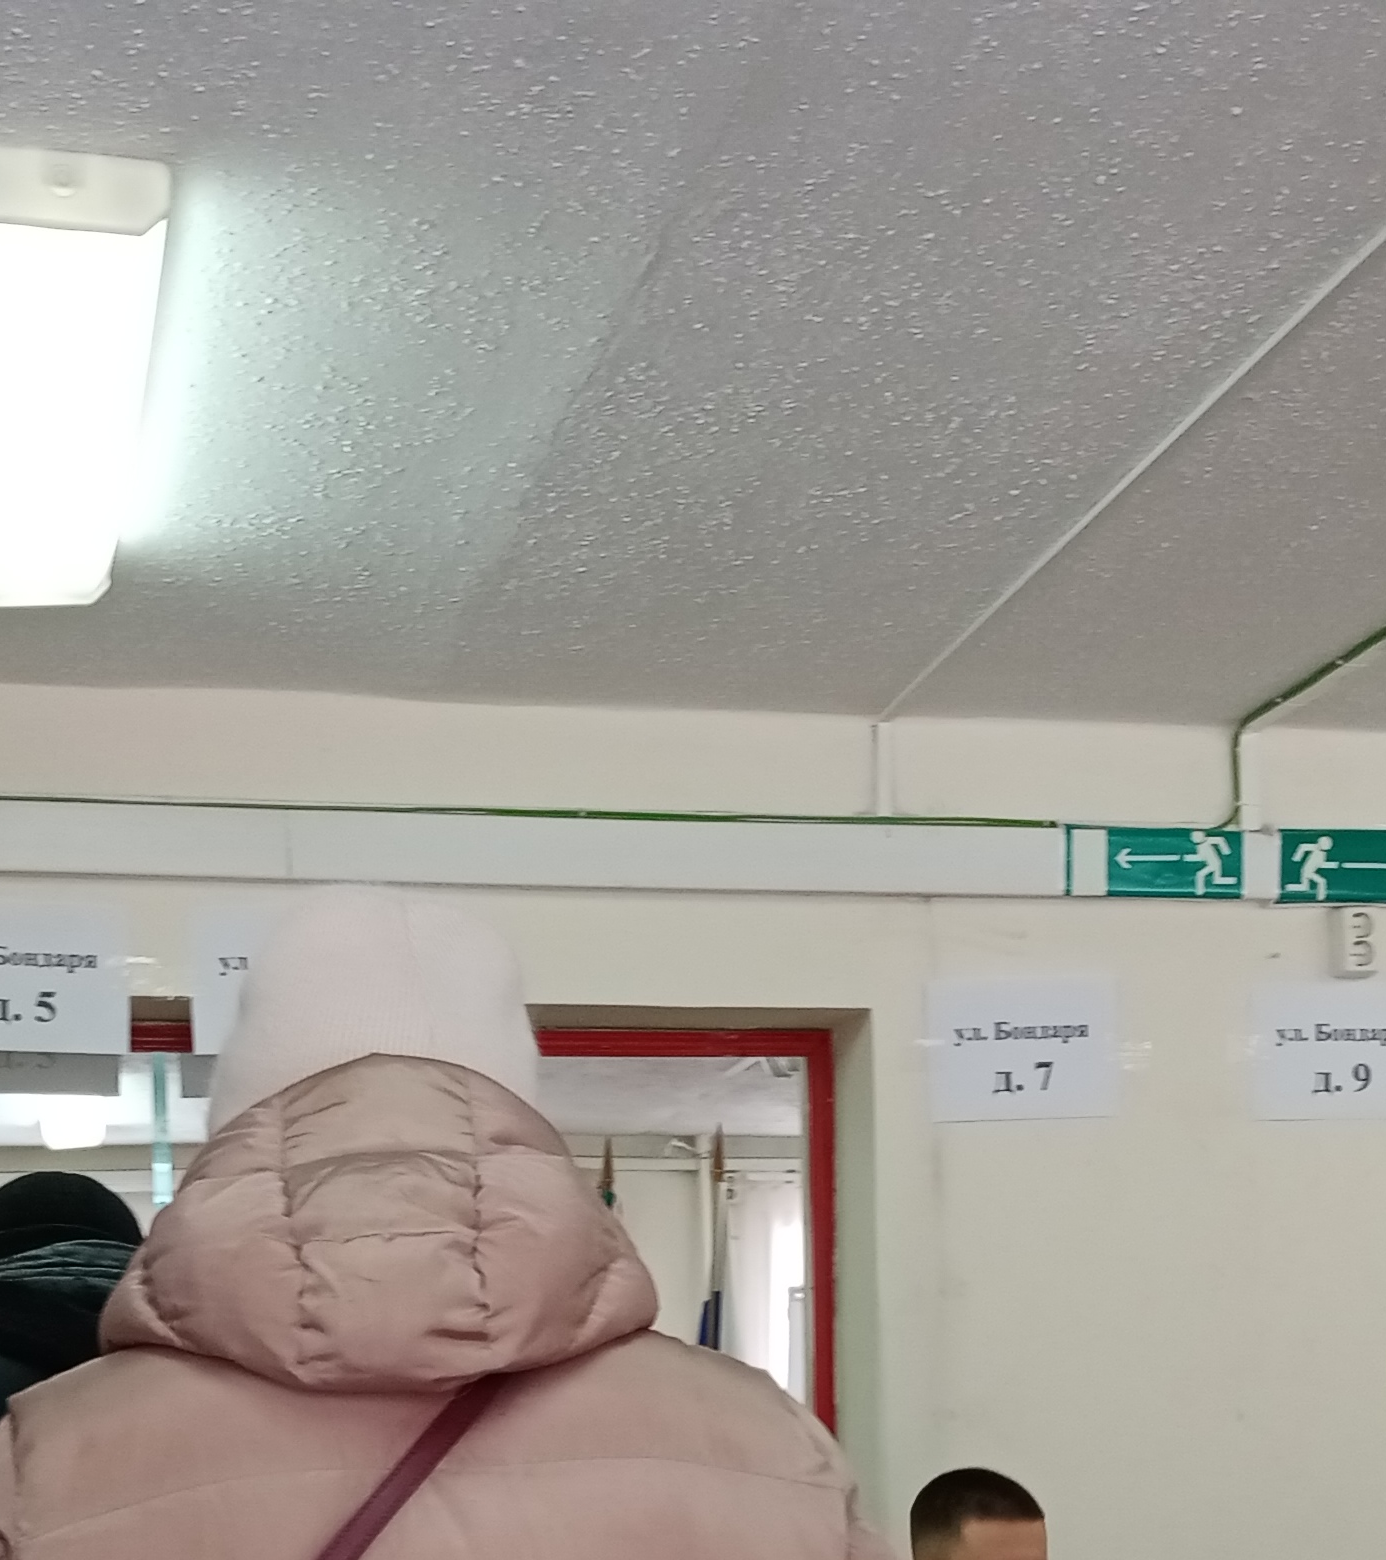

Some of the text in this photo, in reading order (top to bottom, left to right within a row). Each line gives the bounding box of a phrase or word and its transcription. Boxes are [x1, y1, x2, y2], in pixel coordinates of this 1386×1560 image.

[34, 991, 58, 1023] 5
[952, 1021, 1090, 1047] ул. Бондаря
[1275, 1028, 1310, 1047] ул.
[992, 1061, 1055, 1094] д. 7
[1311, 1063, 1373, 1094] д. 9
